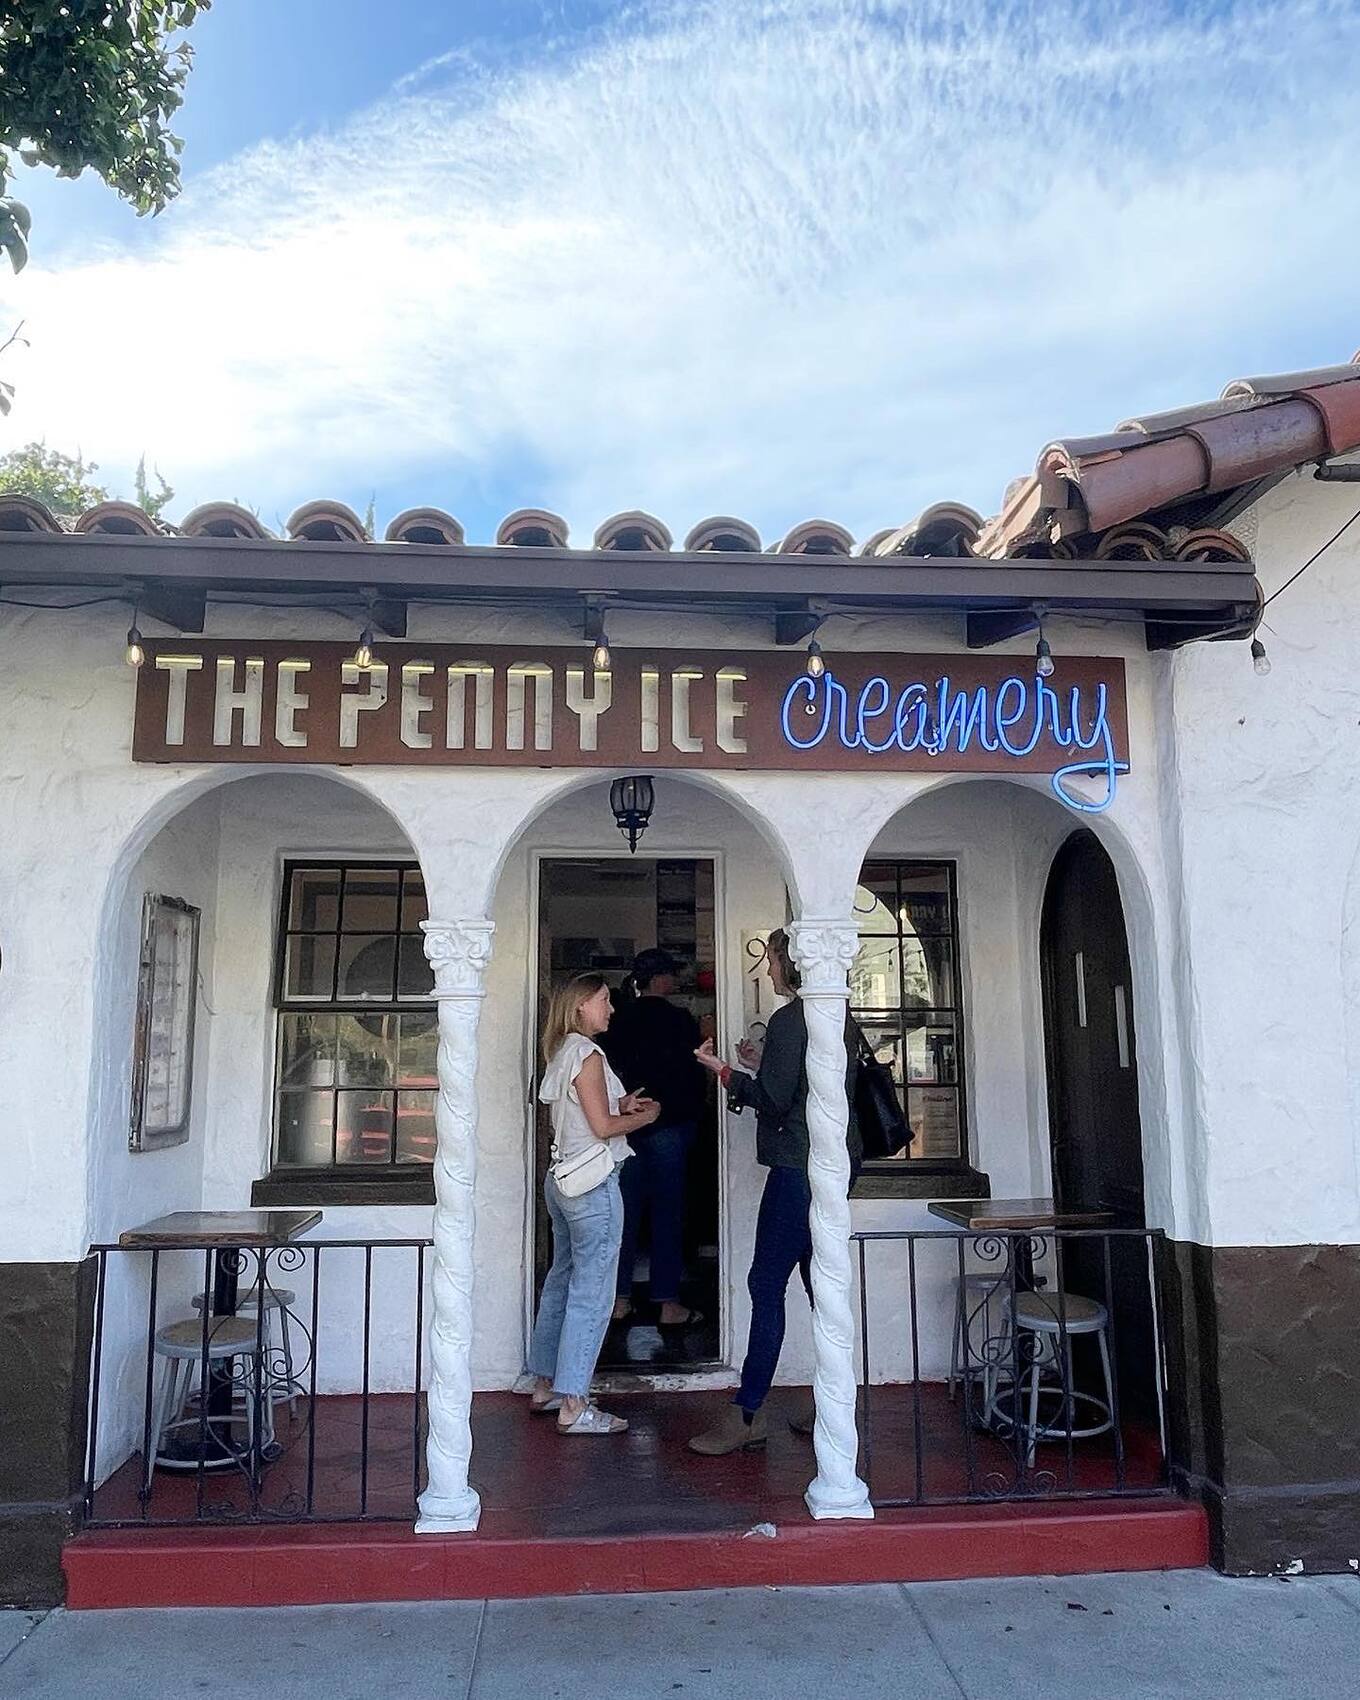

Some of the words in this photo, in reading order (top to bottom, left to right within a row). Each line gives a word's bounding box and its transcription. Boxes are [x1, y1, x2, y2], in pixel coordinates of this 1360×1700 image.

[155, 656, 312, 746] THE
[339, 660, 613, 752] PENNY
[639, 665, 748, 754] ICE
